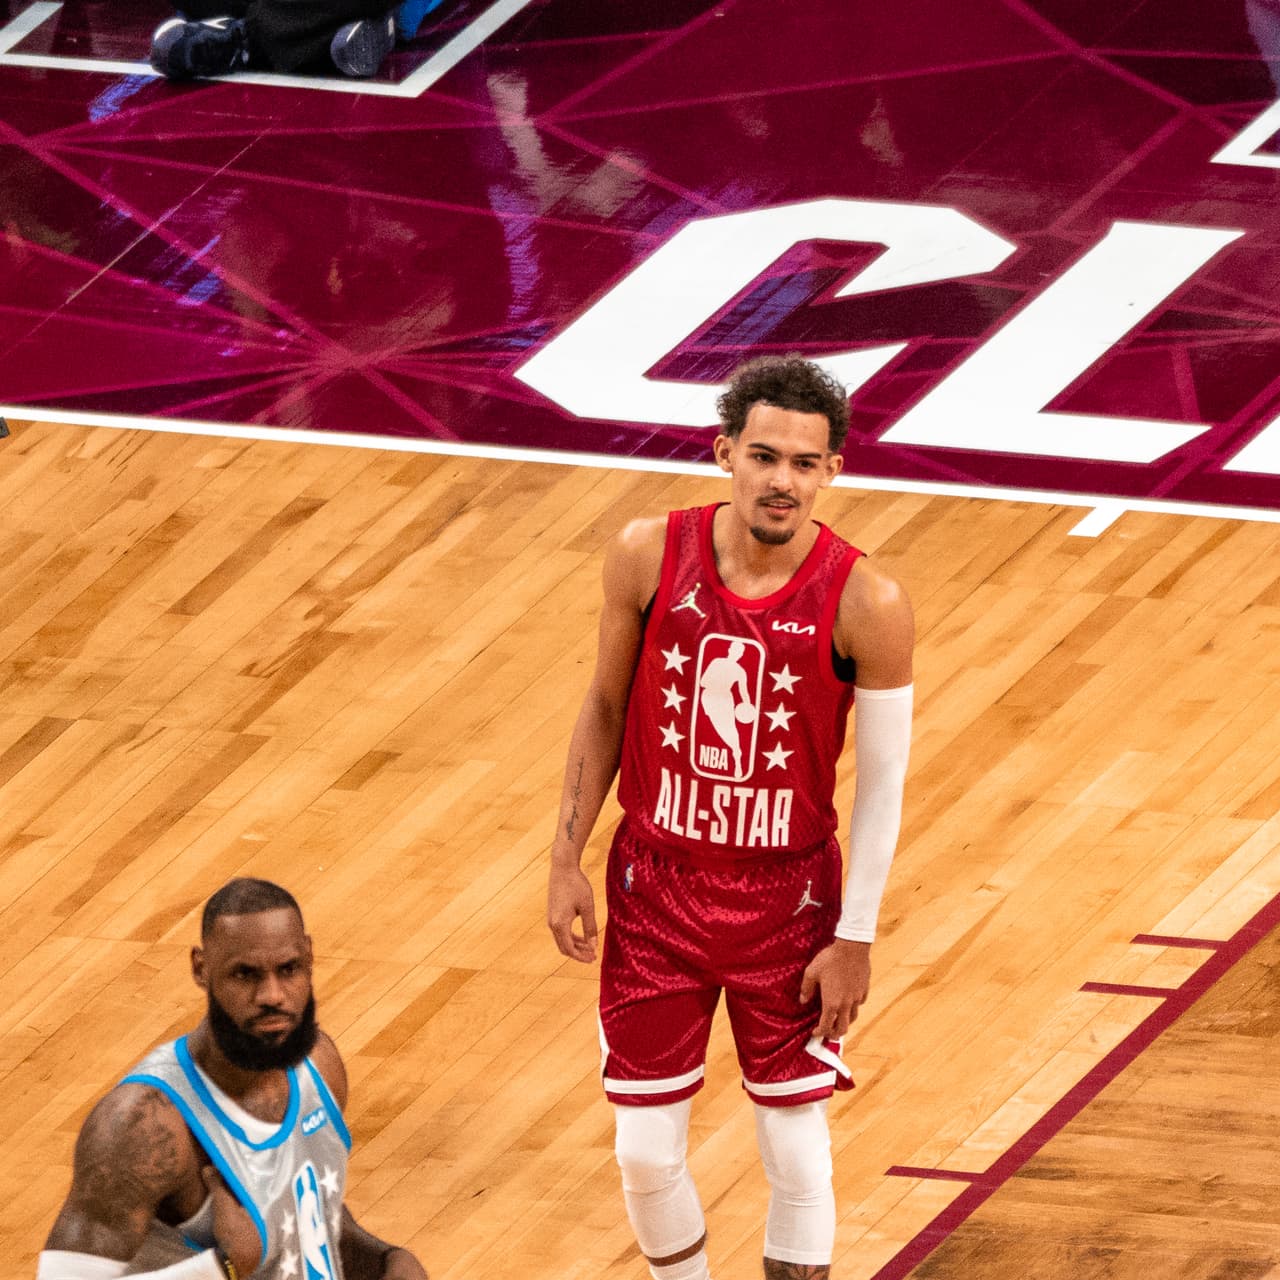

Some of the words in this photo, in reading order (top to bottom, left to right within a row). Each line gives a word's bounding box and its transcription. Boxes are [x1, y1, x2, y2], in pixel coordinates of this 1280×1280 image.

[772, 620, 816, 636] KIA
[699, 744, 728, 771] NBA
[653, 768, 794, 847] ALL-STAR
